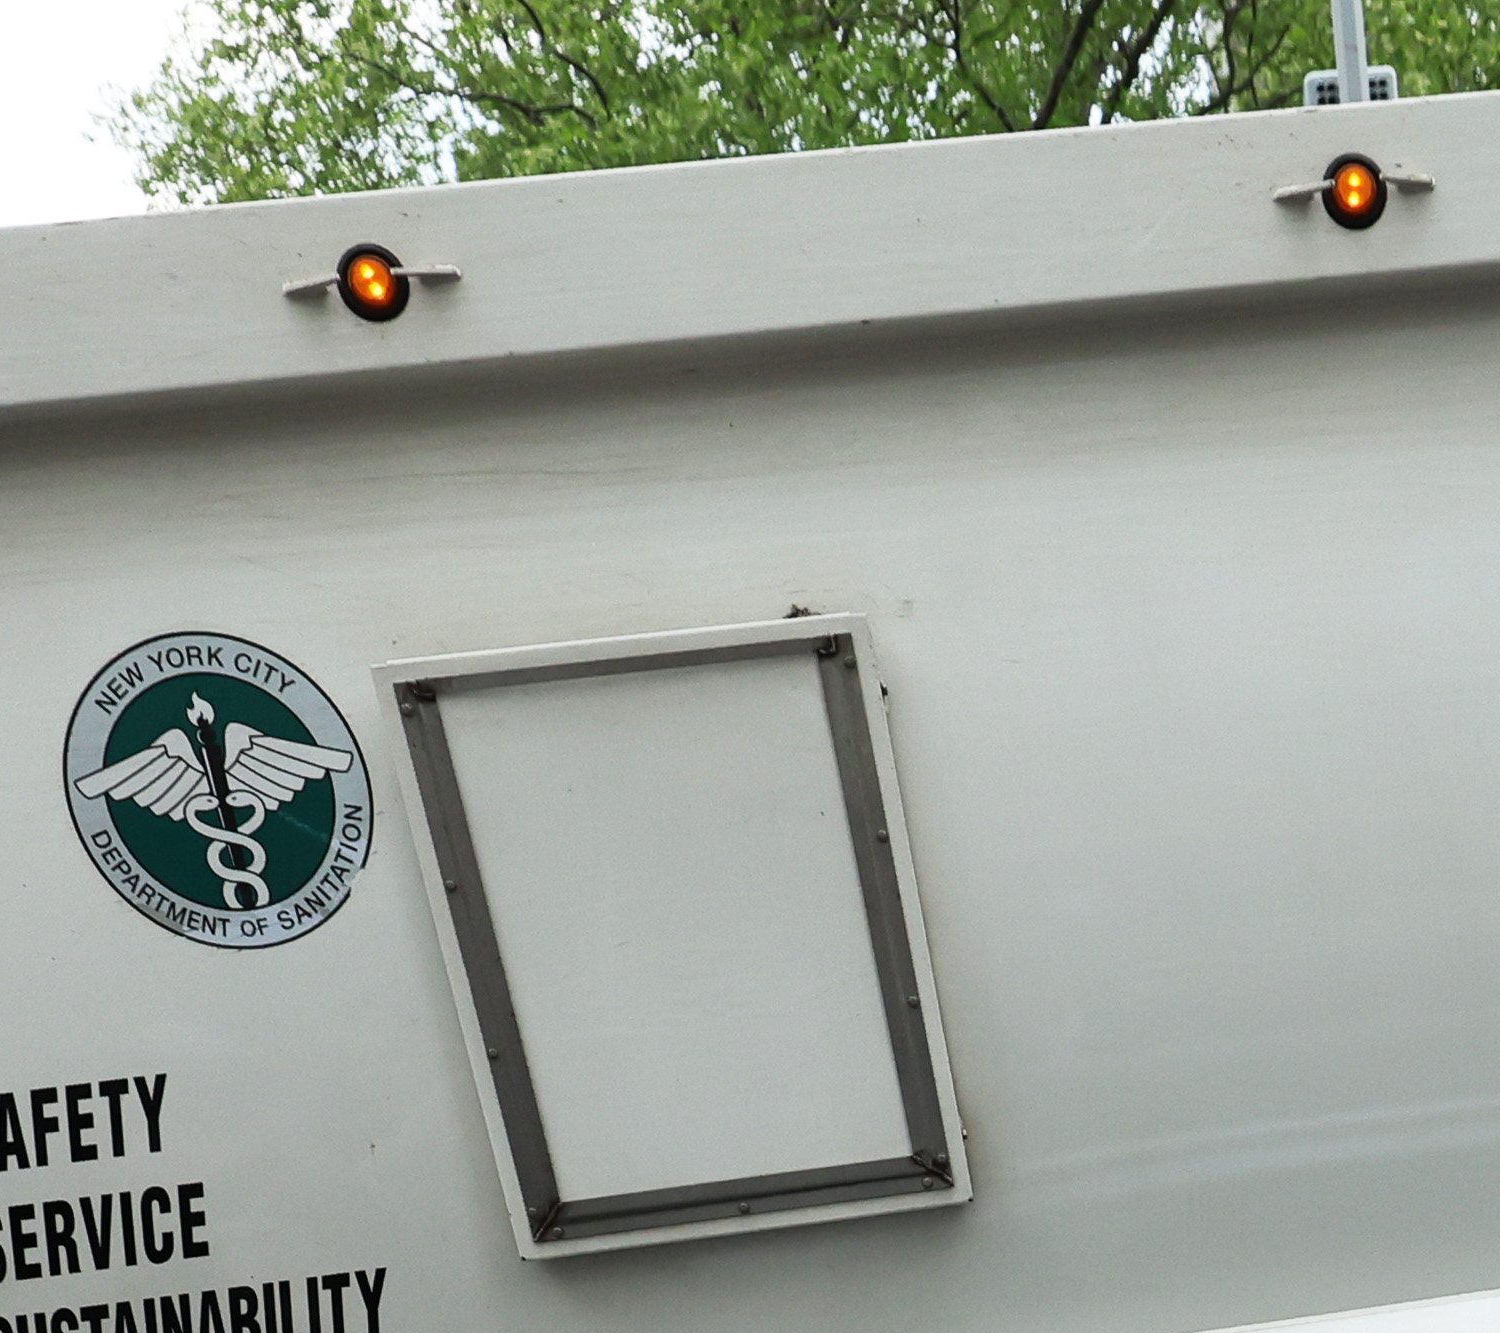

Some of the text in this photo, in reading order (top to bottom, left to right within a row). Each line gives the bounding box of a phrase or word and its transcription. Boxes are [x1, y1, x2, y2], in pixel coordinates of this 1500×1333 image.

[94, 645, 296, 715] NEW YORK CITY
[90, 802, 363, 937] DEPARTMENT OF SANITATION
